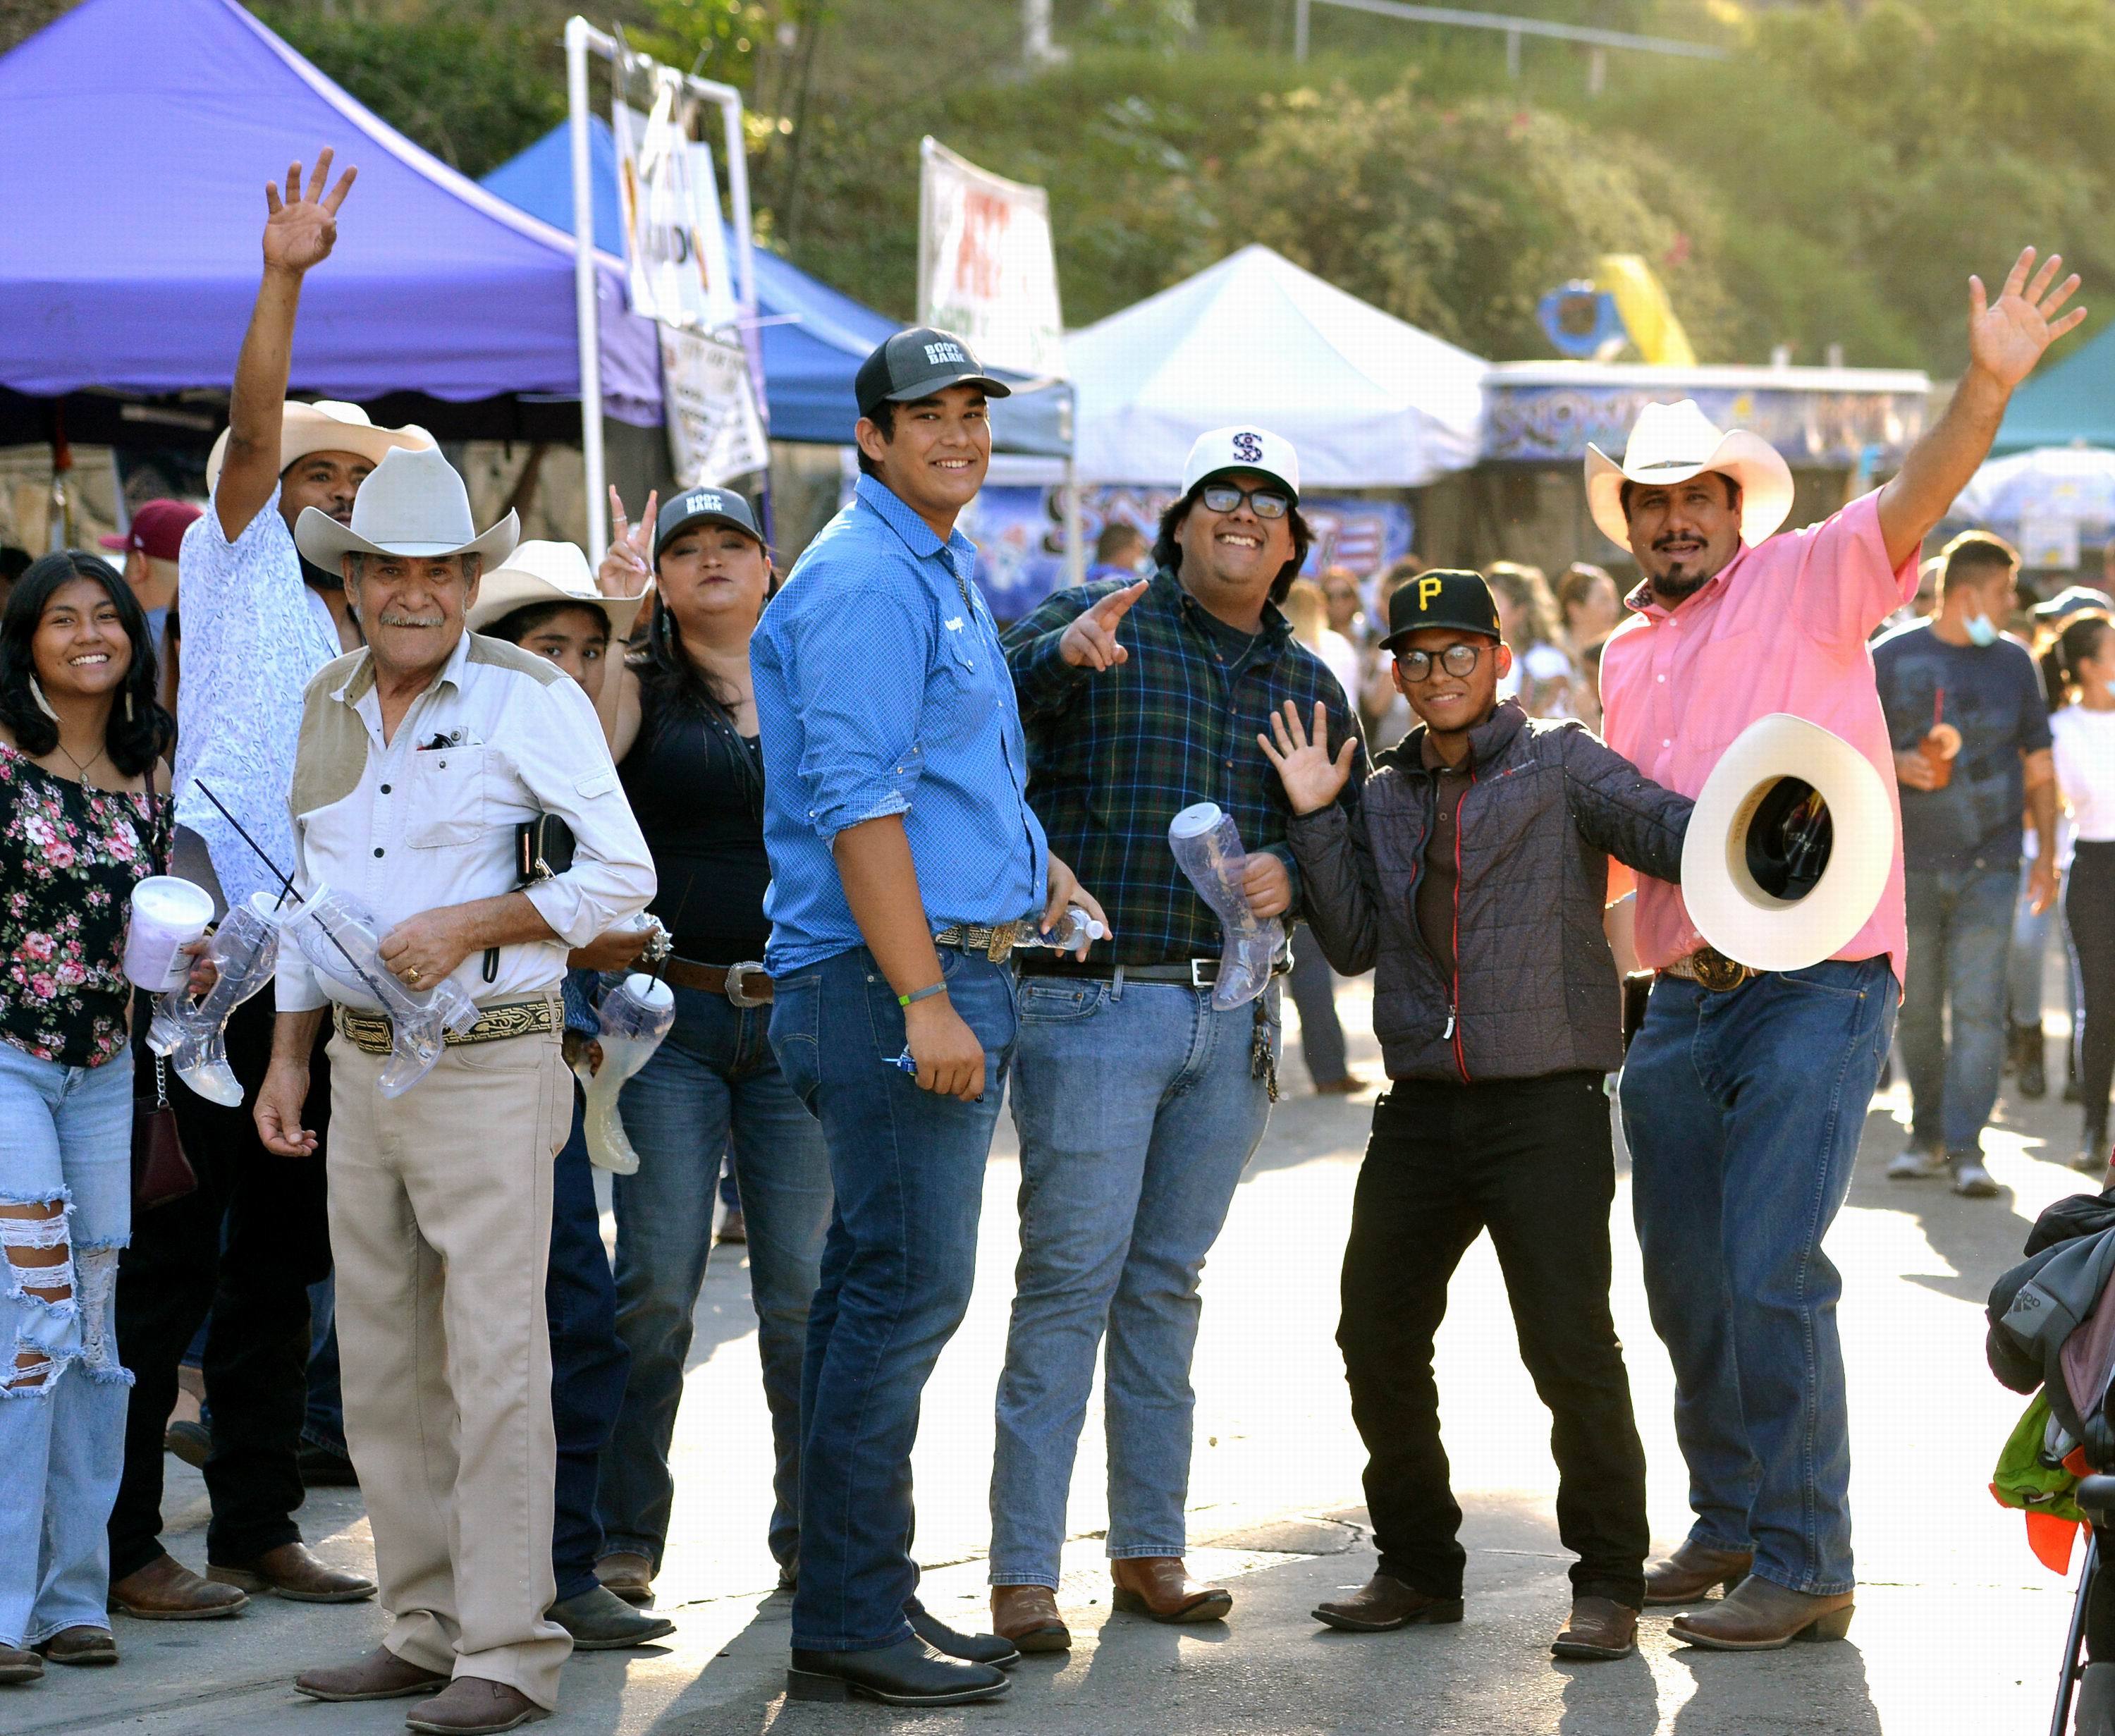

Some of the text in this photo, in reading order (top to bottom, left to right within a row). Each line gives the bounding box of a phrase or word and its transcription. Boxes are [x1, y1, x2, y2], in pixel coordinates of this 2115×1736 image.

[924, 342, 960, 355] BOOT
[927, 352, 965, 365] BARN
[686, 494, 723, 506] BOOT
[687, 502, 724, 515] BARN
[1418, 577, 1442, 611] P
